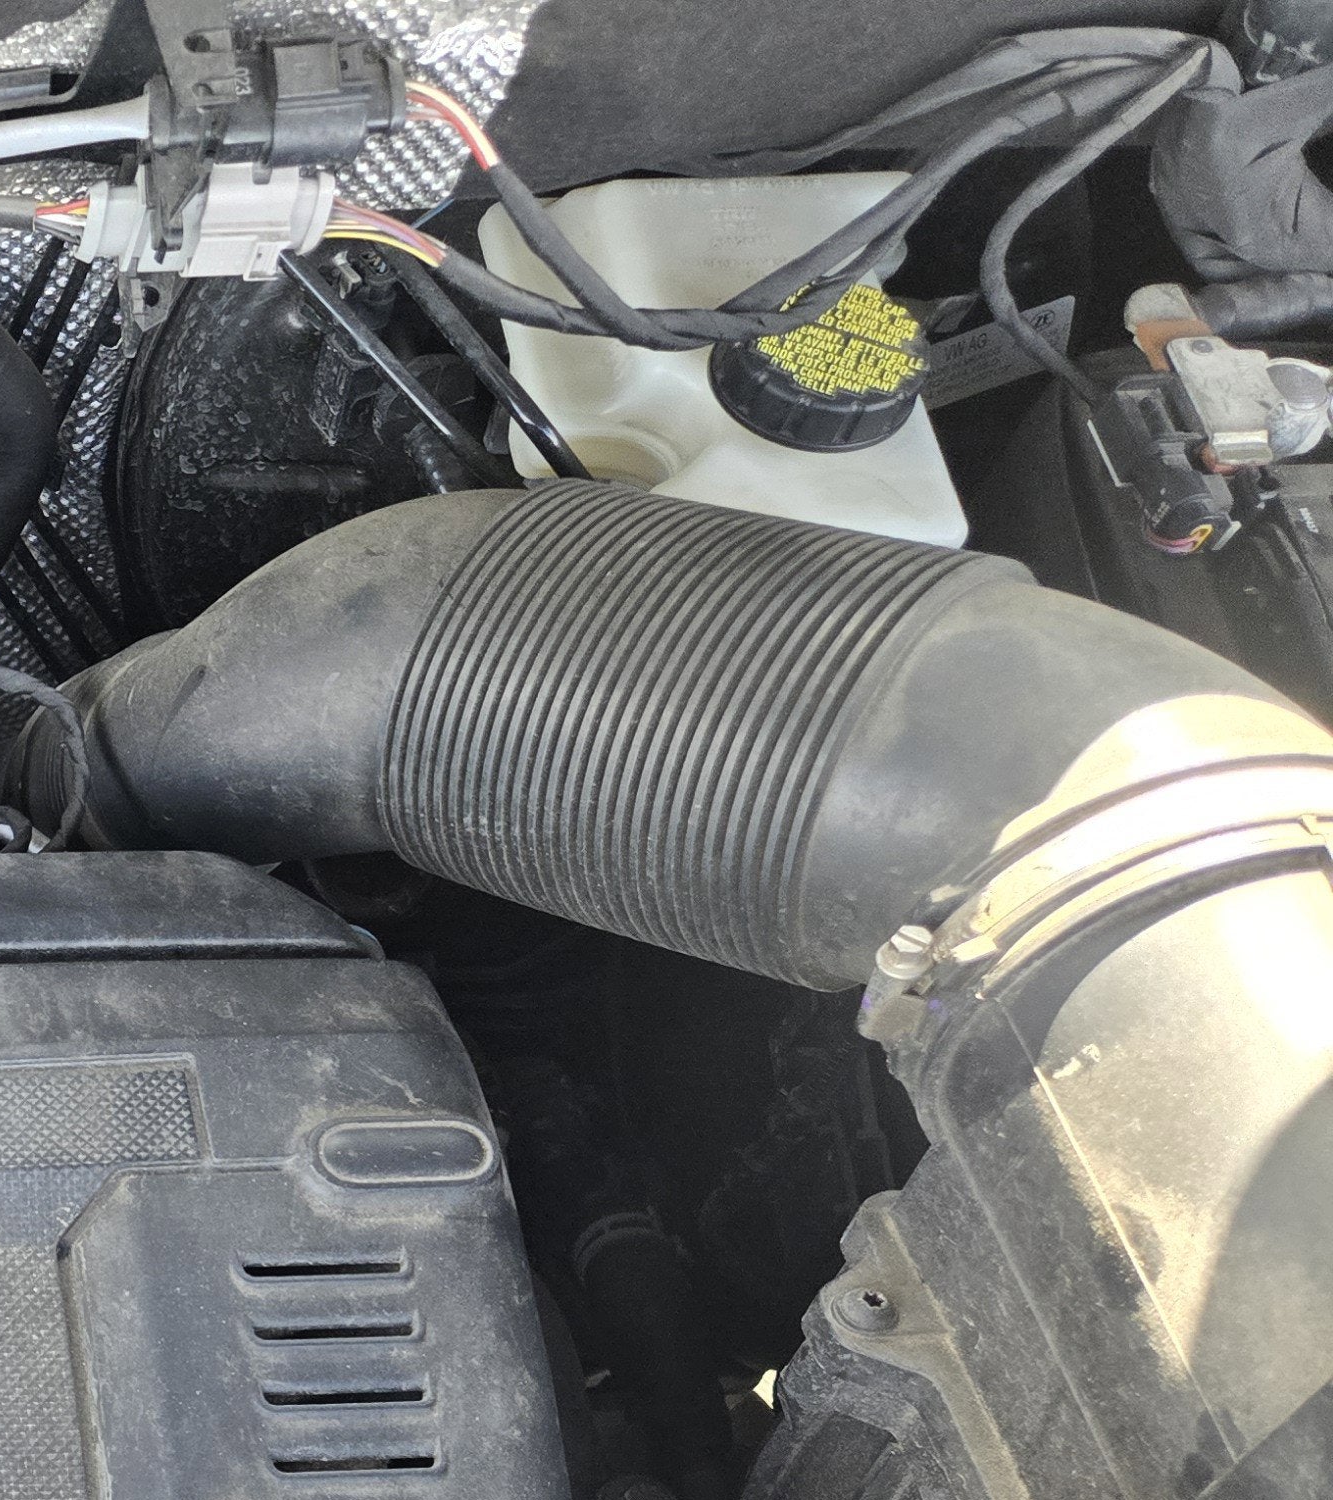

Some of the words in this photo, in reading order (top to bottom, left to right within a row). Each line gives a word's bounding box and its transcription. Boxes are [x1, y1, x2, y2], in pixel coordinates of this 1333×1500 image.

[883, 303, 908, 317] CAP
[894, 315, 919, 333] USE
[844, 312, 879, 330] FLUID
[880, 323, 917, 341] FROM
[783, 340, 855, 370] N'EMPLOYER
[857, 363, 882, 378] QUE
[883, 371, 901, 384] DU
[803, 336, 842, 354] AVANT
[843, 347, 859, 360] DE
[860, 353, 877, 366] LE
[847, 338, 908, 365] NETTOYER
[908, 357, 924, 370] LE
[796, 355, 826, 371] DOT4
[828, 364, 897, 392] PROVENANT
[800, 366, 868, 394] CONTENANT
